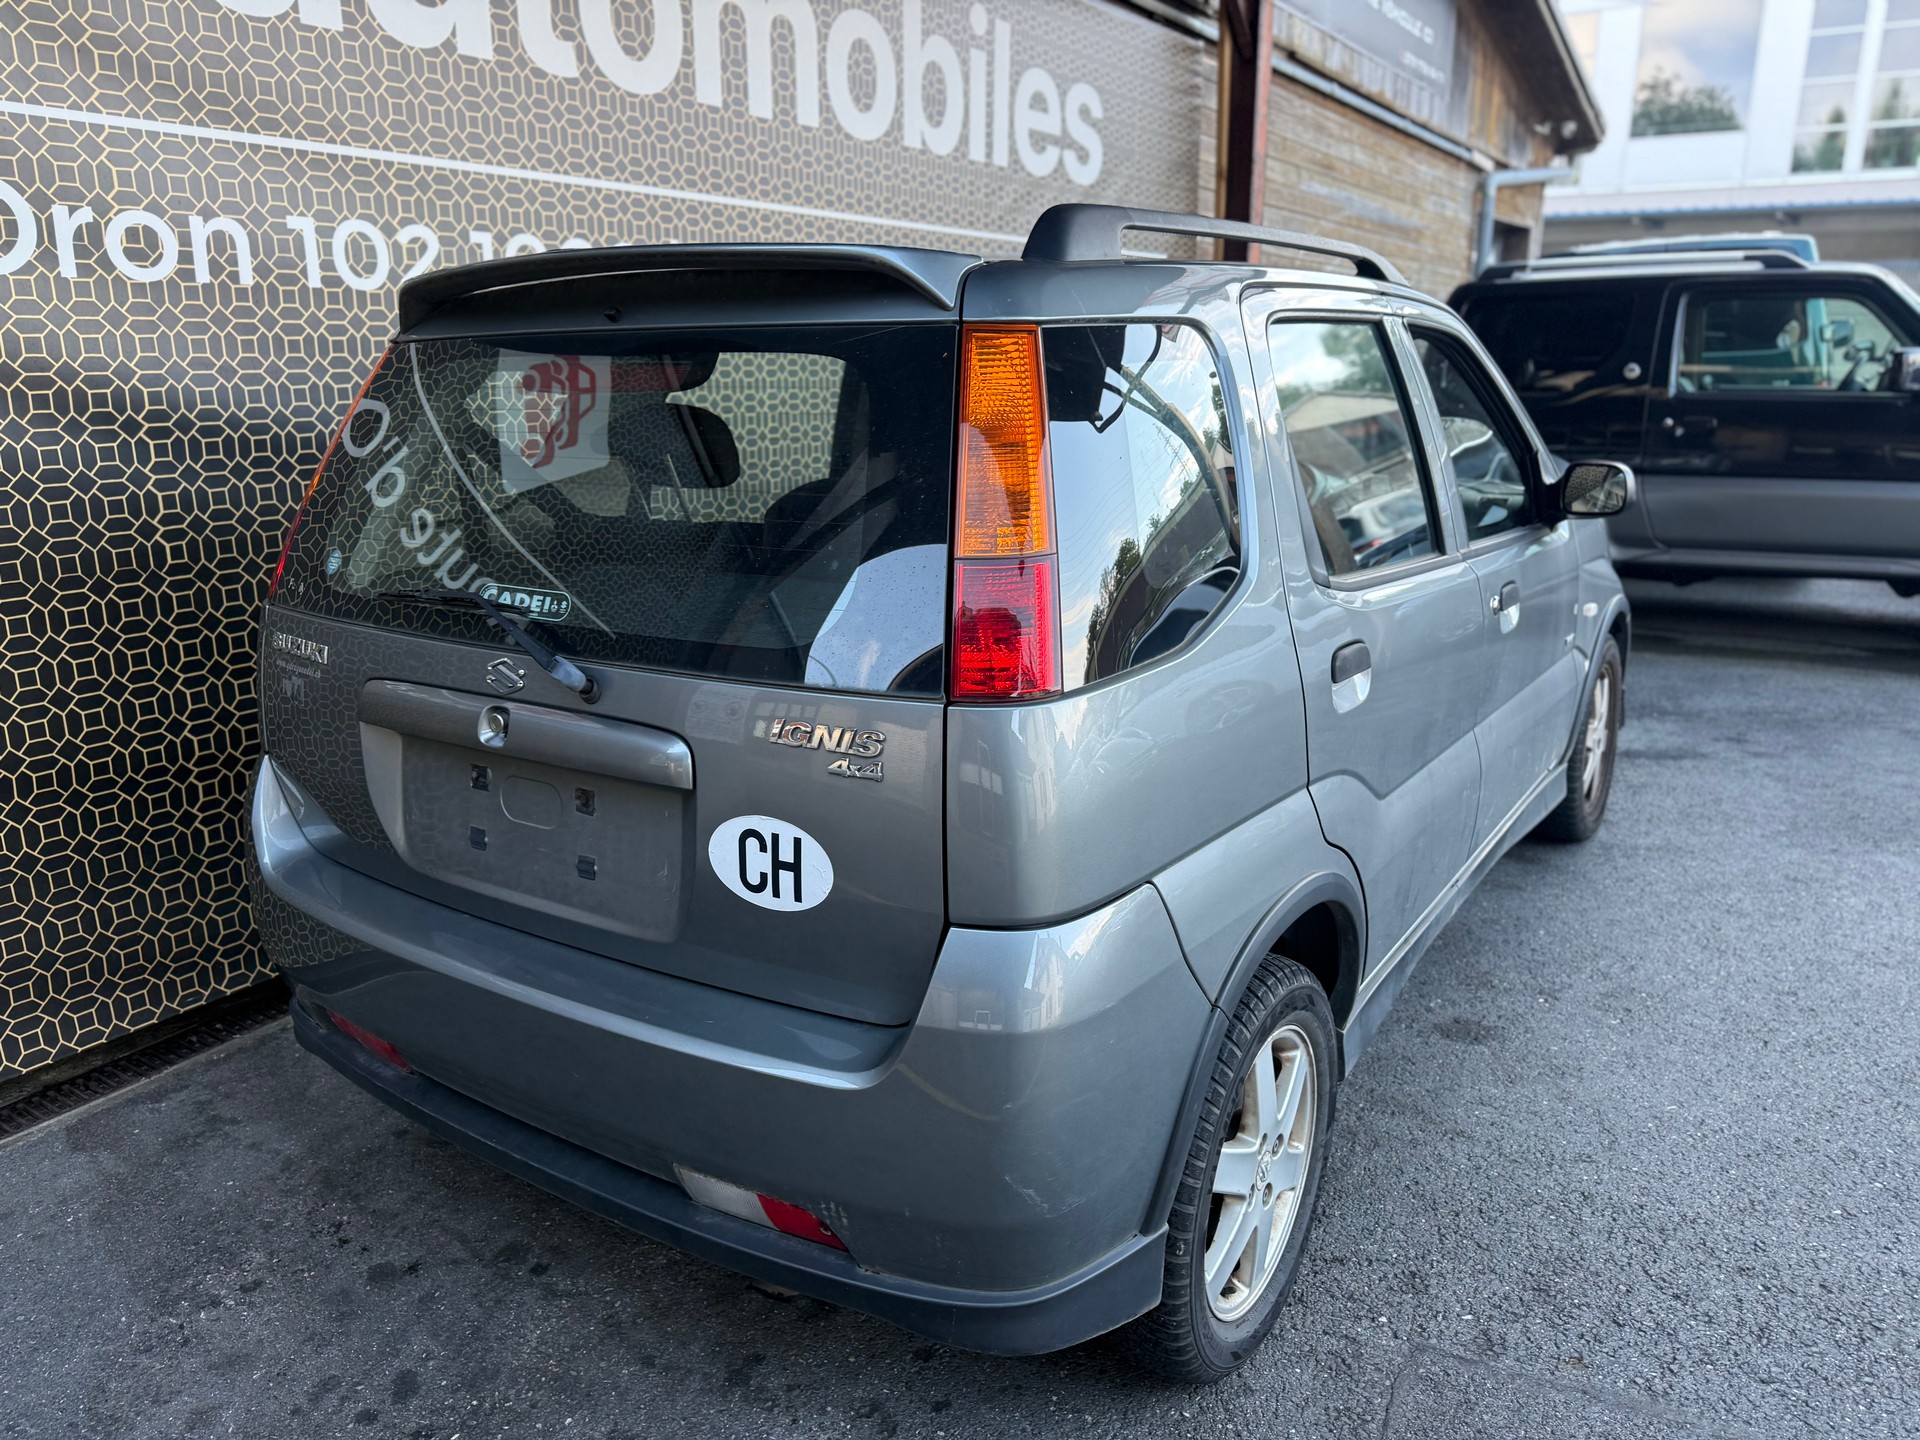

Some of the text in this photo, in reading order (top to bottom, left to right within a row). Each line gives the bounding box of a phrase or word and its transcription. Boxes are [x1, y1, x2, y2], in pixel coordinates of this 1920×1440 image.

[213, 0, 1103, 187] omobiles
[286, 215, 440, 291] 102
[273, 632, 328, 665] SUZUKI
[769, 718, 886, 757] IGNIS
[827, 757, 884, 782] 4x4
[738, 828, 802, 904] CH
